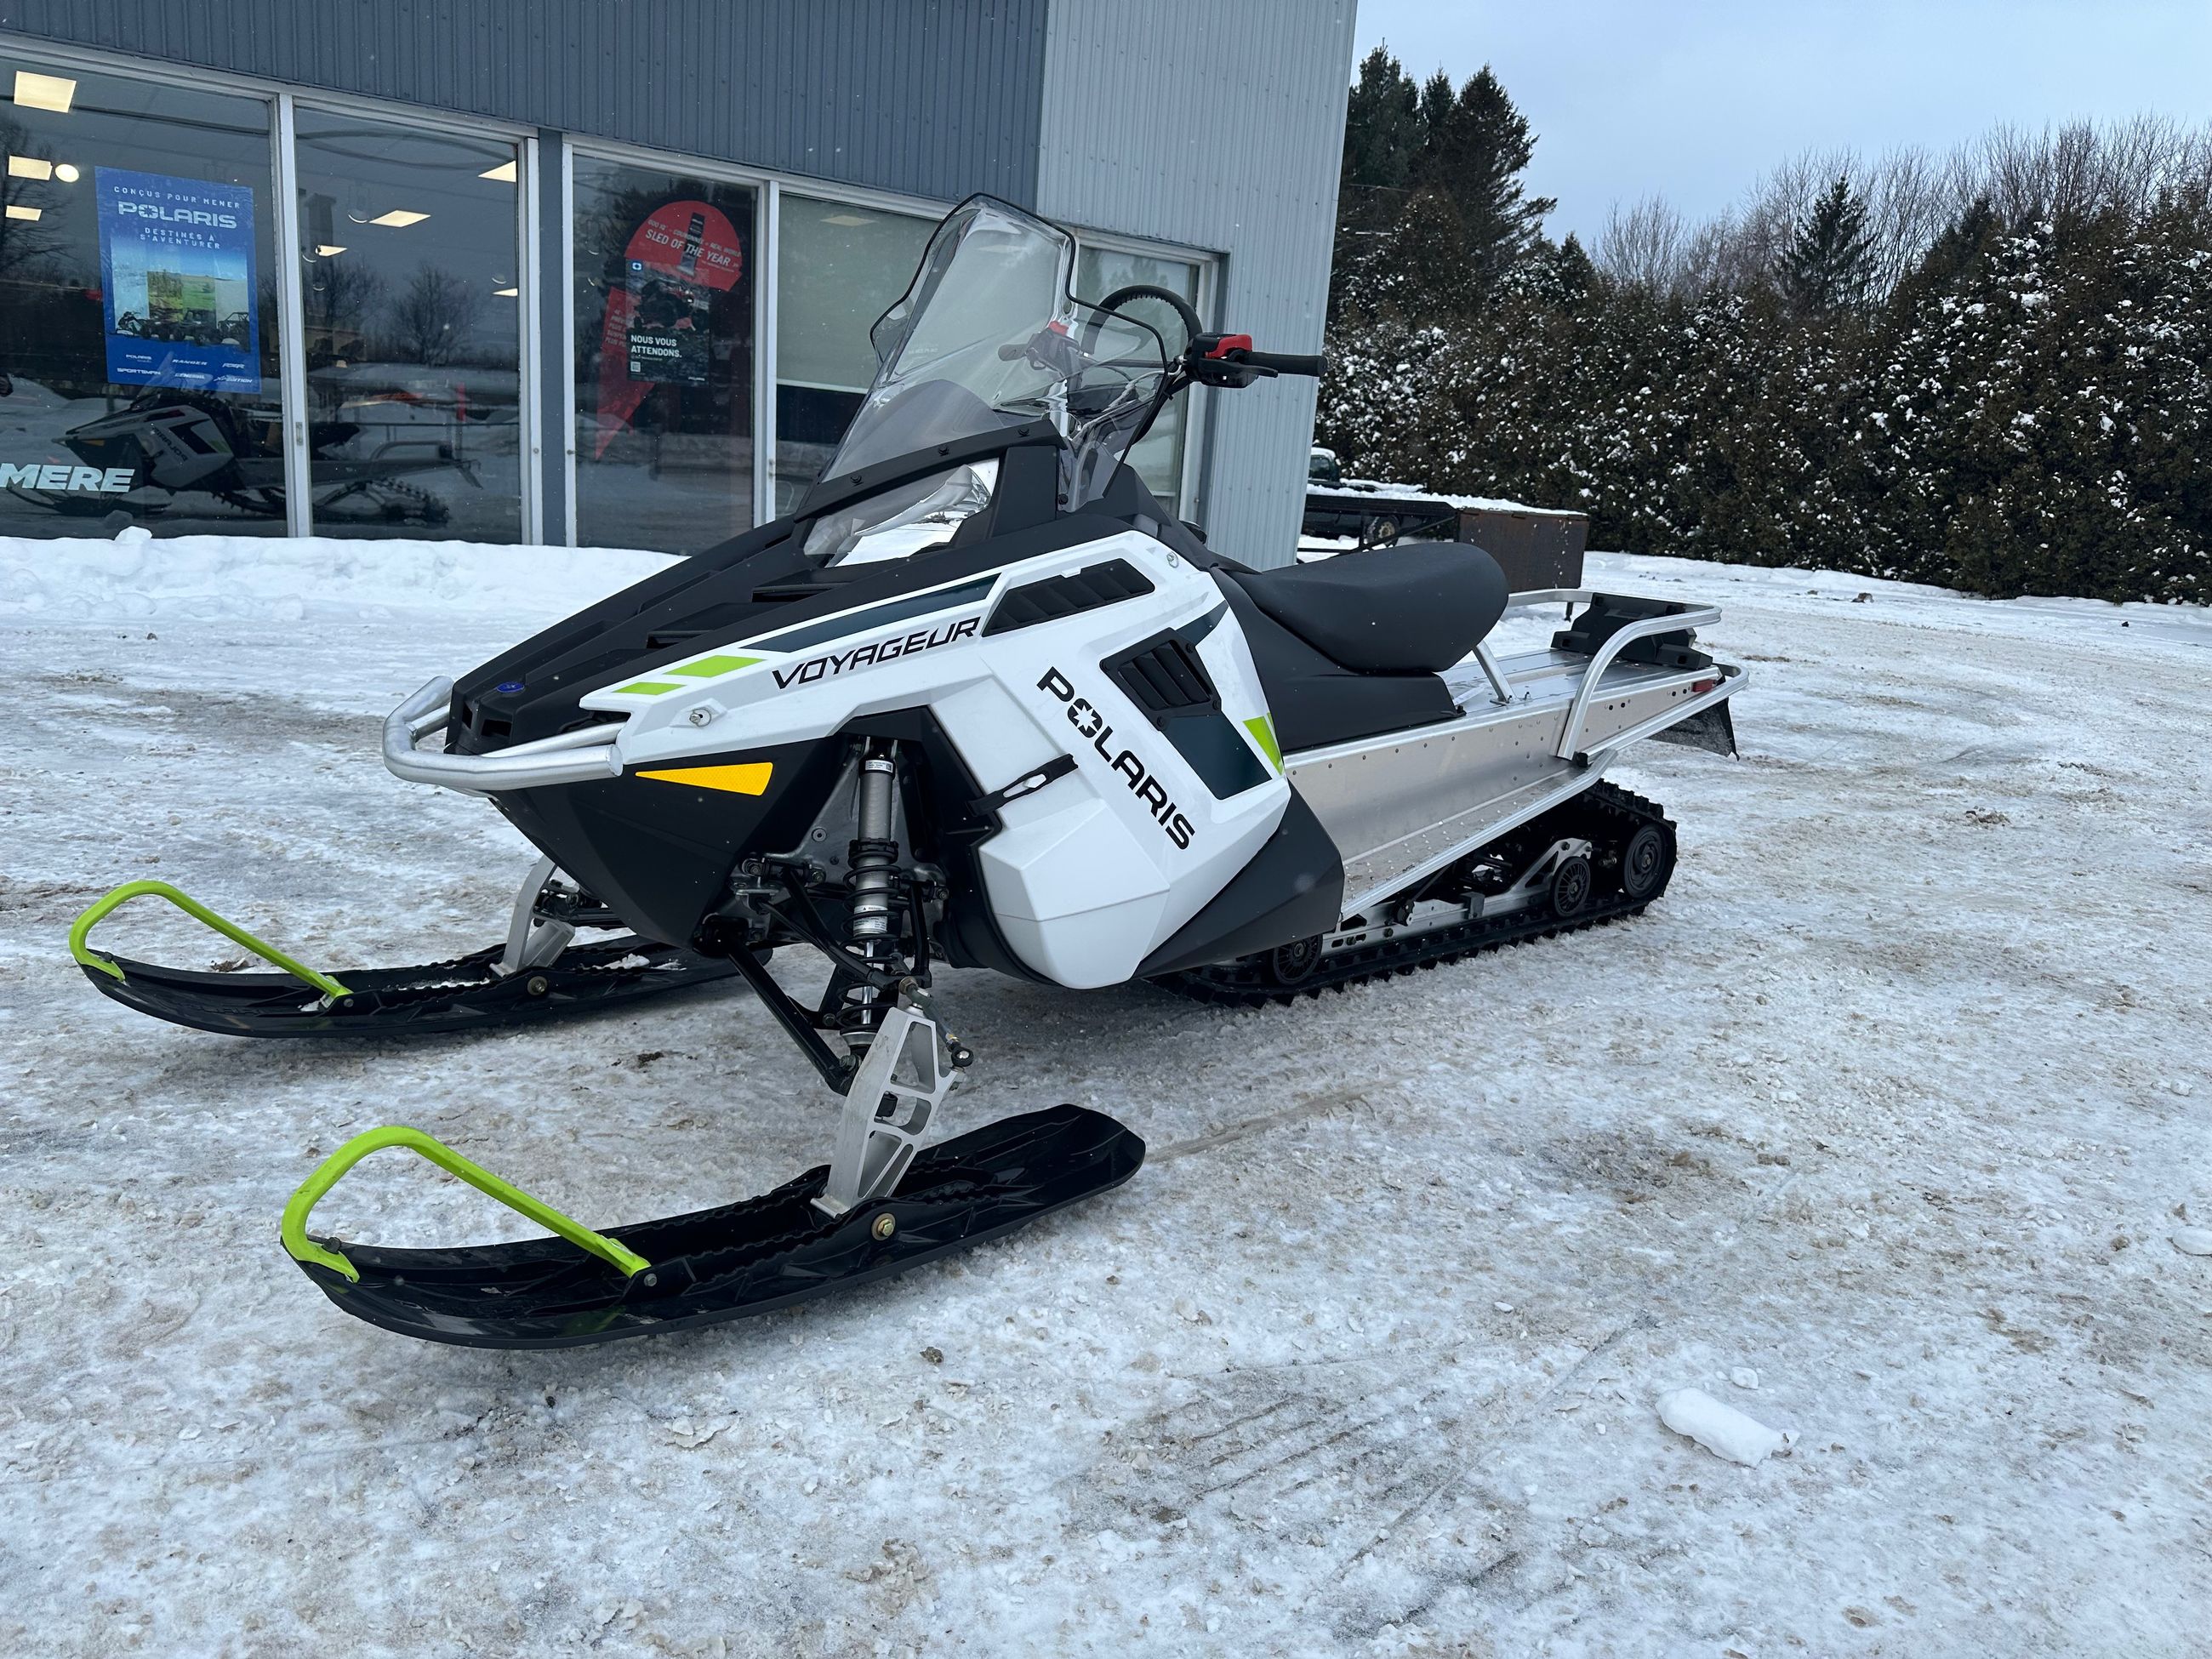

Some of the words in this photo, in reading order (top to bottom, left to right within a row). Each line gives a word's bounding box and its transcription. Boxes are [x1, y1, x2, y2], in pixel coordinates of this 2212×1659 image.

[114, 186, 160, 198] CONÇUS
[167, 193, 197, 203] POUR
[203, 197, 240, 208] MENER
[117, 201, 237, 229] POLARIS
[140, 234, 220, 249] S'AVENTURER
[646, 229, 669, 245] SLED
[670, 238, 686, 249] OF
[686, 243, 704, 257] THE
[706, 251, 731, 266] YEAR
[630, 335, 653, 345] NOUS
[654, 337, 677, 346] VOUS
[630, 345, 682, 358] ATTENDONS.
[0, 463, 135, 493] MERE
[772, 616, 981, 689] VOYAGEUR
[1036, 666, 1195, 850] POLARIS
